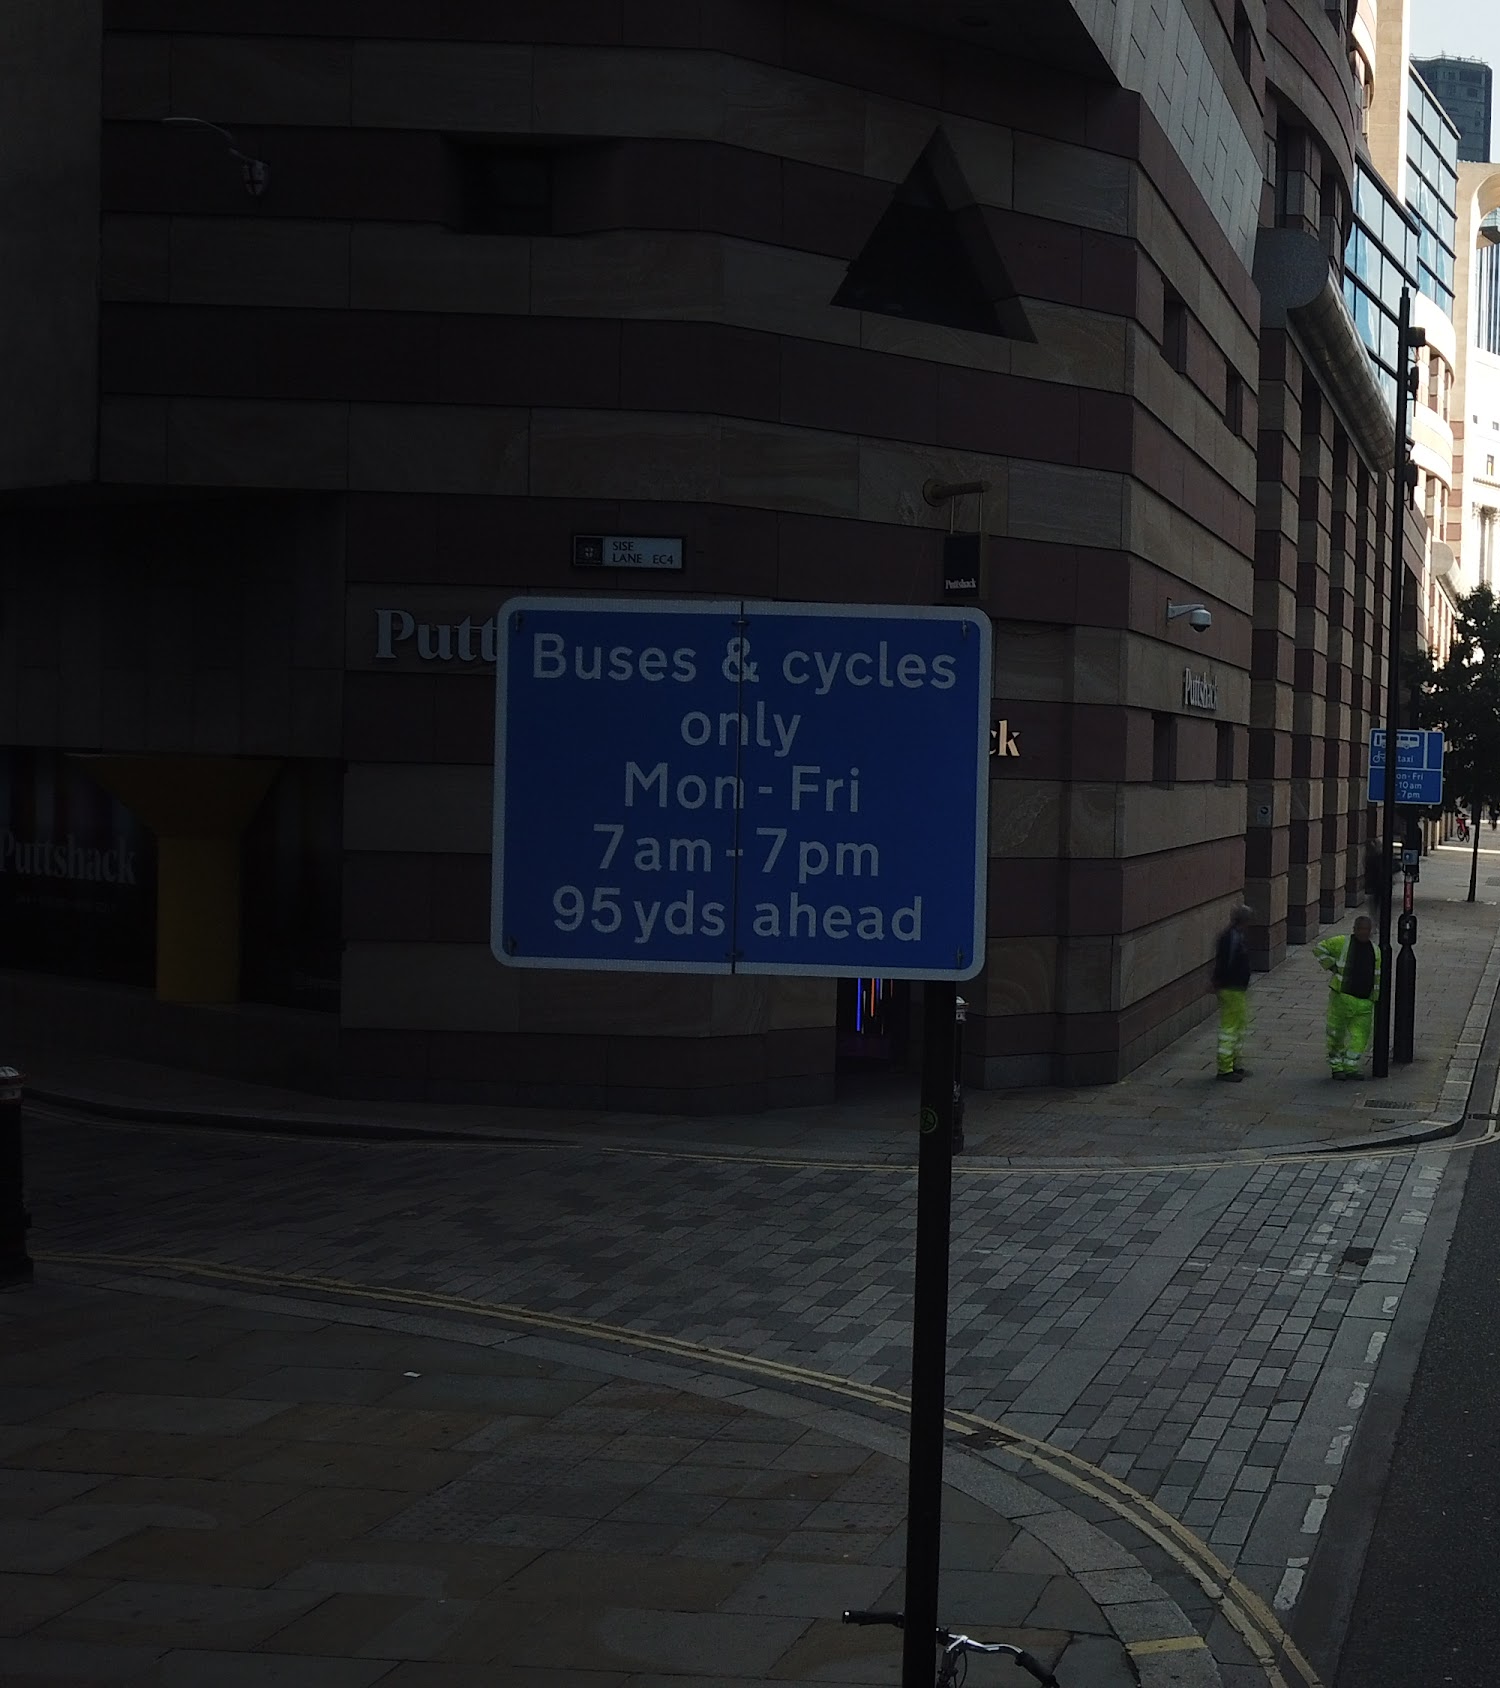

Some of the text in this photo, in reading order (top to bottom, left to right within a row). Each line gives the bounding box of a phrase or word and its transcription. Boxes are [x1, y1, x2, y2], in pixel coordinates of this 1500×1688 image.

[612, 541, 634, 551] SISE
[612, 553, 673, 565] LANE EC4
[374, 607, 498, 662] Putt
[532, 632, 957, 695] Buses & cycles
[680, 700, 802, 758] only
[1397, 755, 1414, 763] taxi
[624, 761, 745, 810] Mon
[791, 765, 860, 813] Fri
[752, 891, 922, 941] ahead
